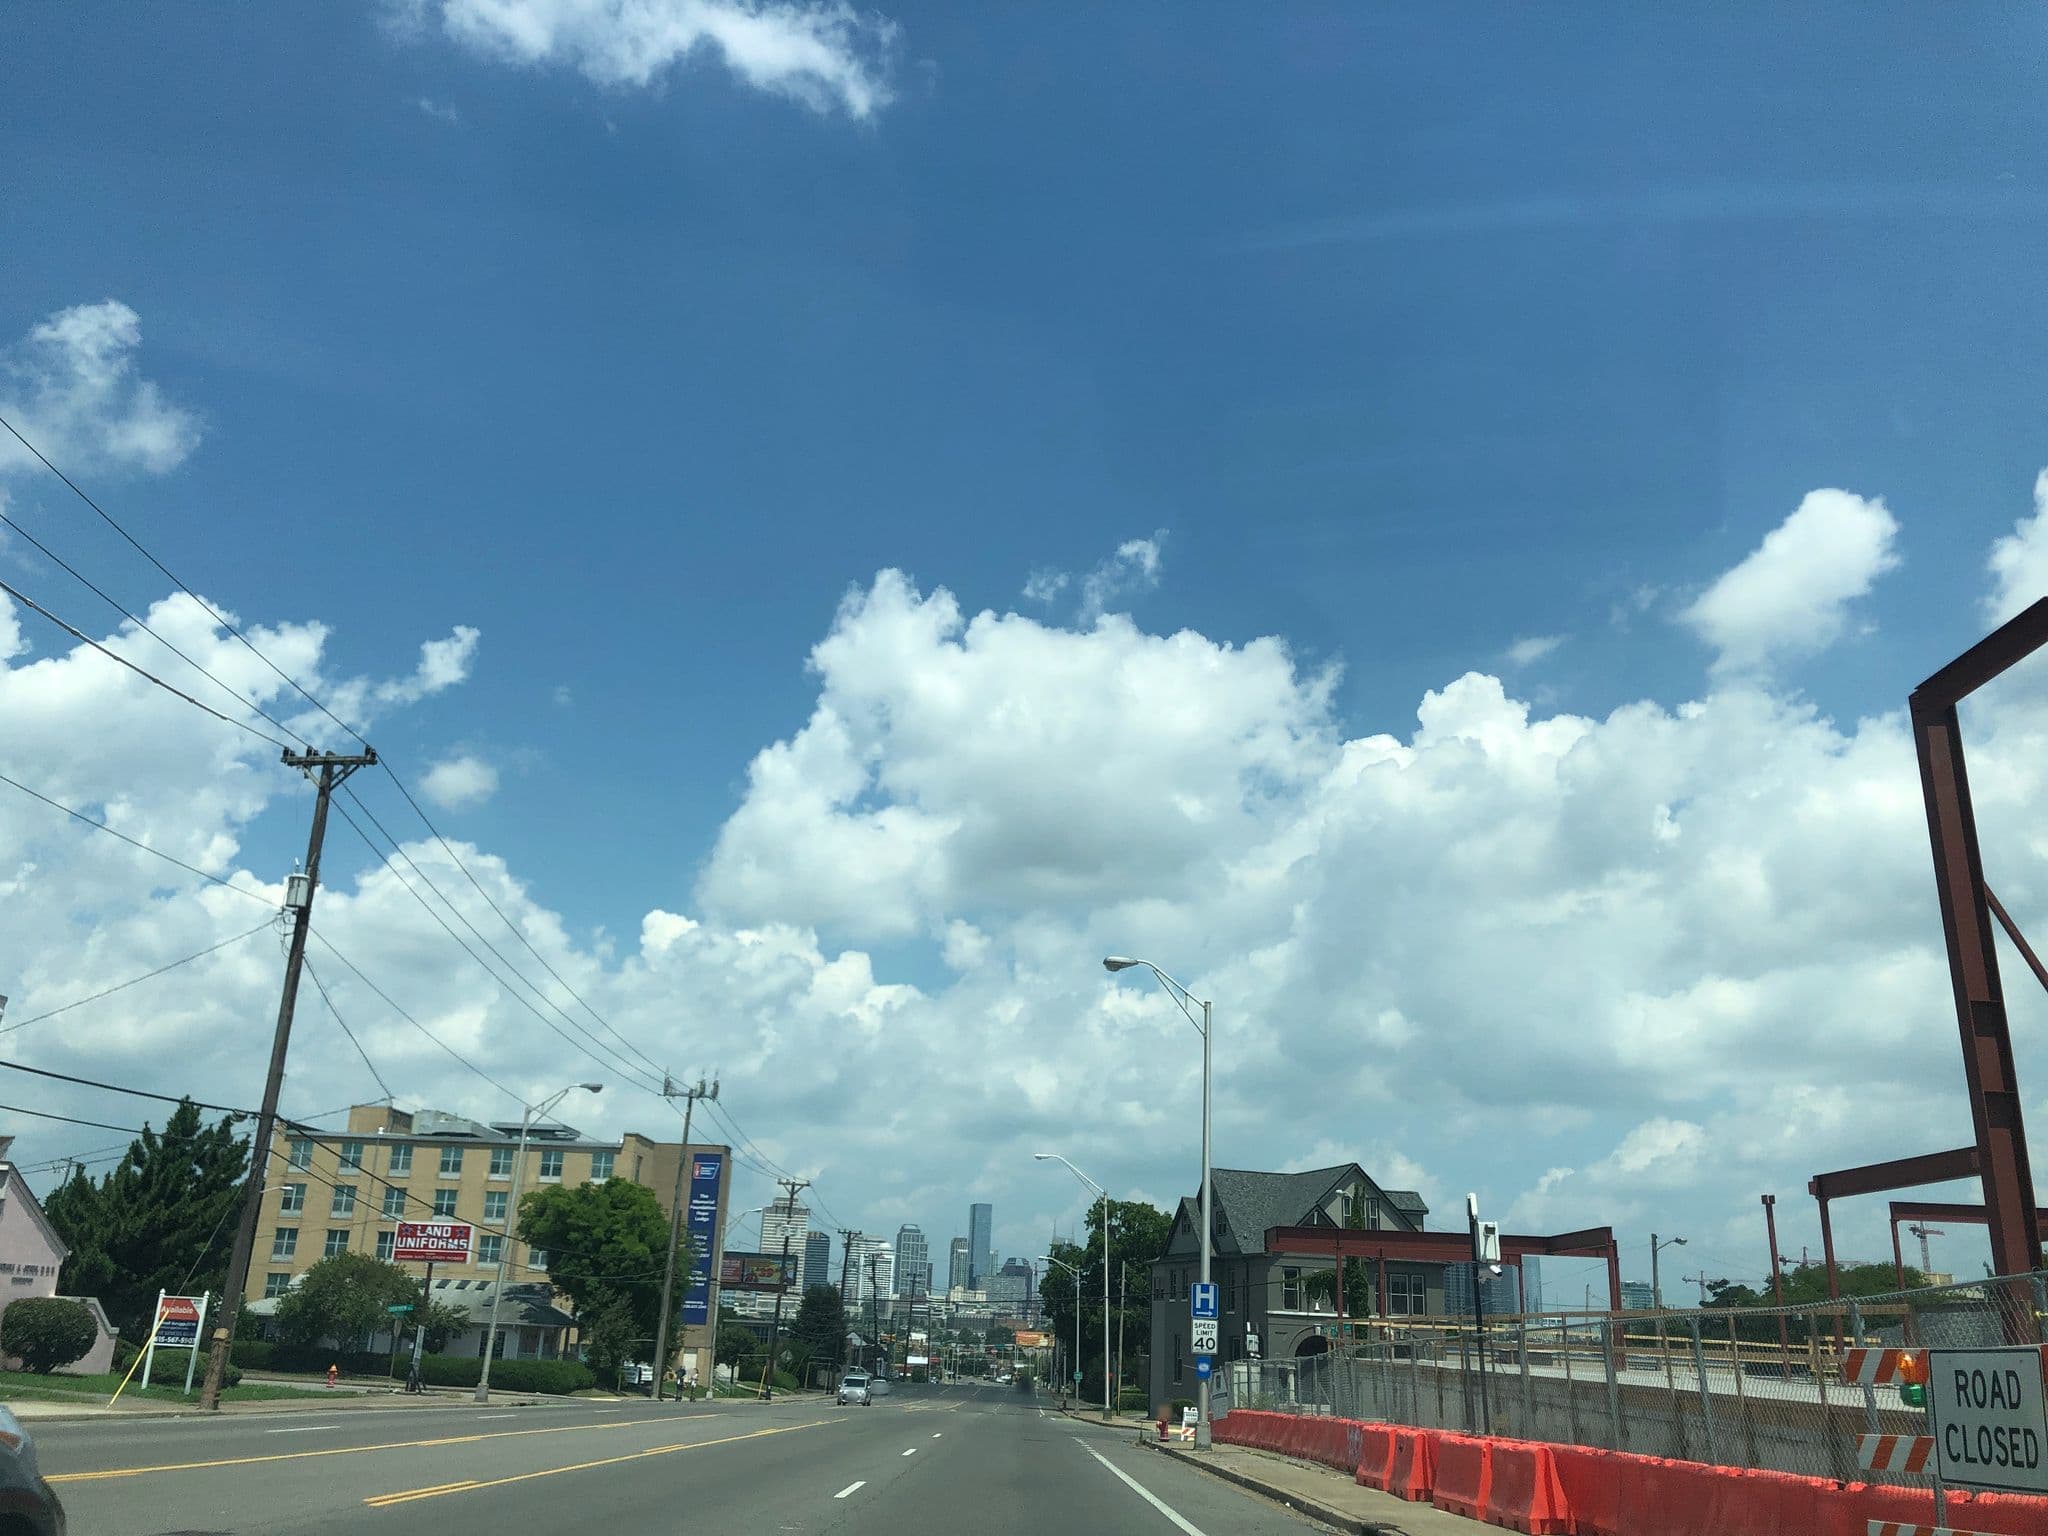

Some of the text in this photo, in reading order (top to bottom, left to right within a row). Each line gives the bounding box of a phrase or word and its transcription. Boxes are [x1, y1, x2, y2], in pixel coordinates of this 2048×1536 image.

[417, 1225, 451, 1237] LAND
[397, 1237, 468, 1249] UNIFORMS
[1195, 1284, 1214, 1309] H
[160, 1305, 194, 1314] Available
[1194, 1337, 1216, 1350] 40
[1954, 1369, 2022, 1410] ROAD
[1945, 1423, 2039, 1469] CLOSED
